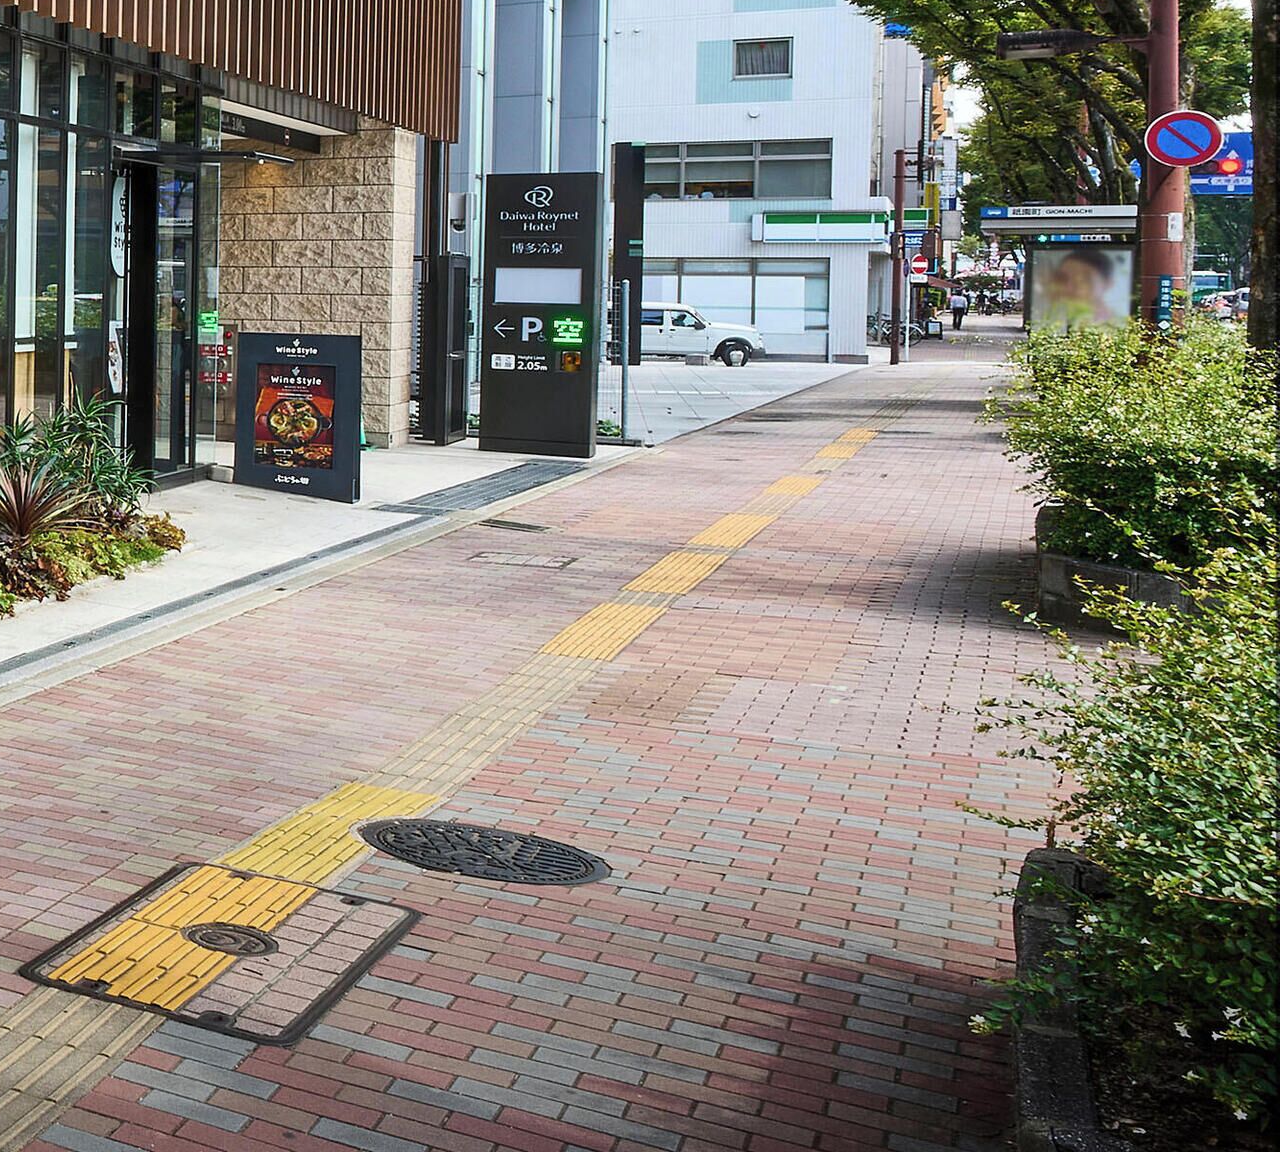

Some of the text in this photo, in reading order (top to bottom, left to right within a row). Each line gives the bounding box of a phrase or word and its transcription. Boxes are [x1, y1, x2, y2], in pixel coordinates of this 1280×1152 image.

[500, 211, 579, 222] Daiwa Roynet
[523, 222, 556, 231] Hotel
[552, 317, 584, 343] 空
[517, 361, 548, 371] 2.05m
[270, 375, 322, 387] Wine Style
